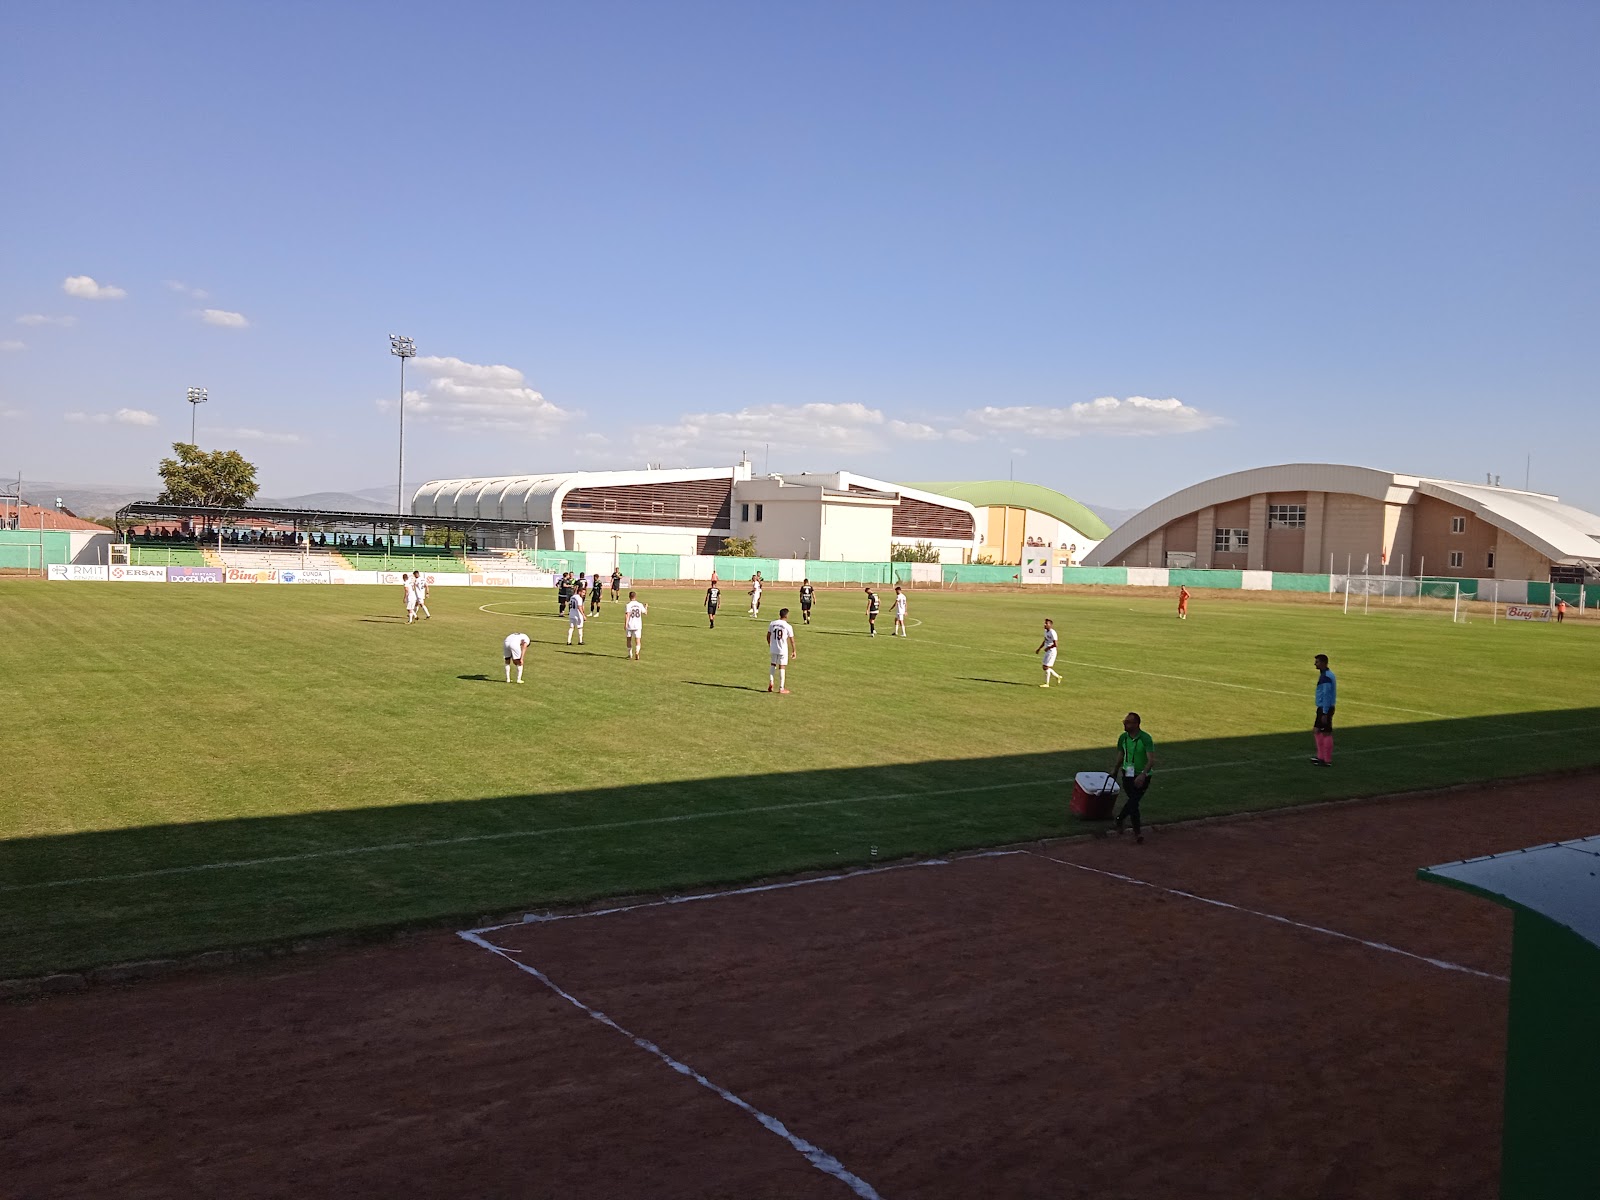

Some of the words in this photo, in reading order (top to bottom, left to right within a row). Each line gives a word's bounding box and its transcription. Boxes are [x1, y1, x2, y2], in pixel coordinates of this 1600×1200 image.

[73, 565, 103, 575] RMIT
[126, 569, 163, 577] ERSAN
[773, 628, 783, 641] 19
